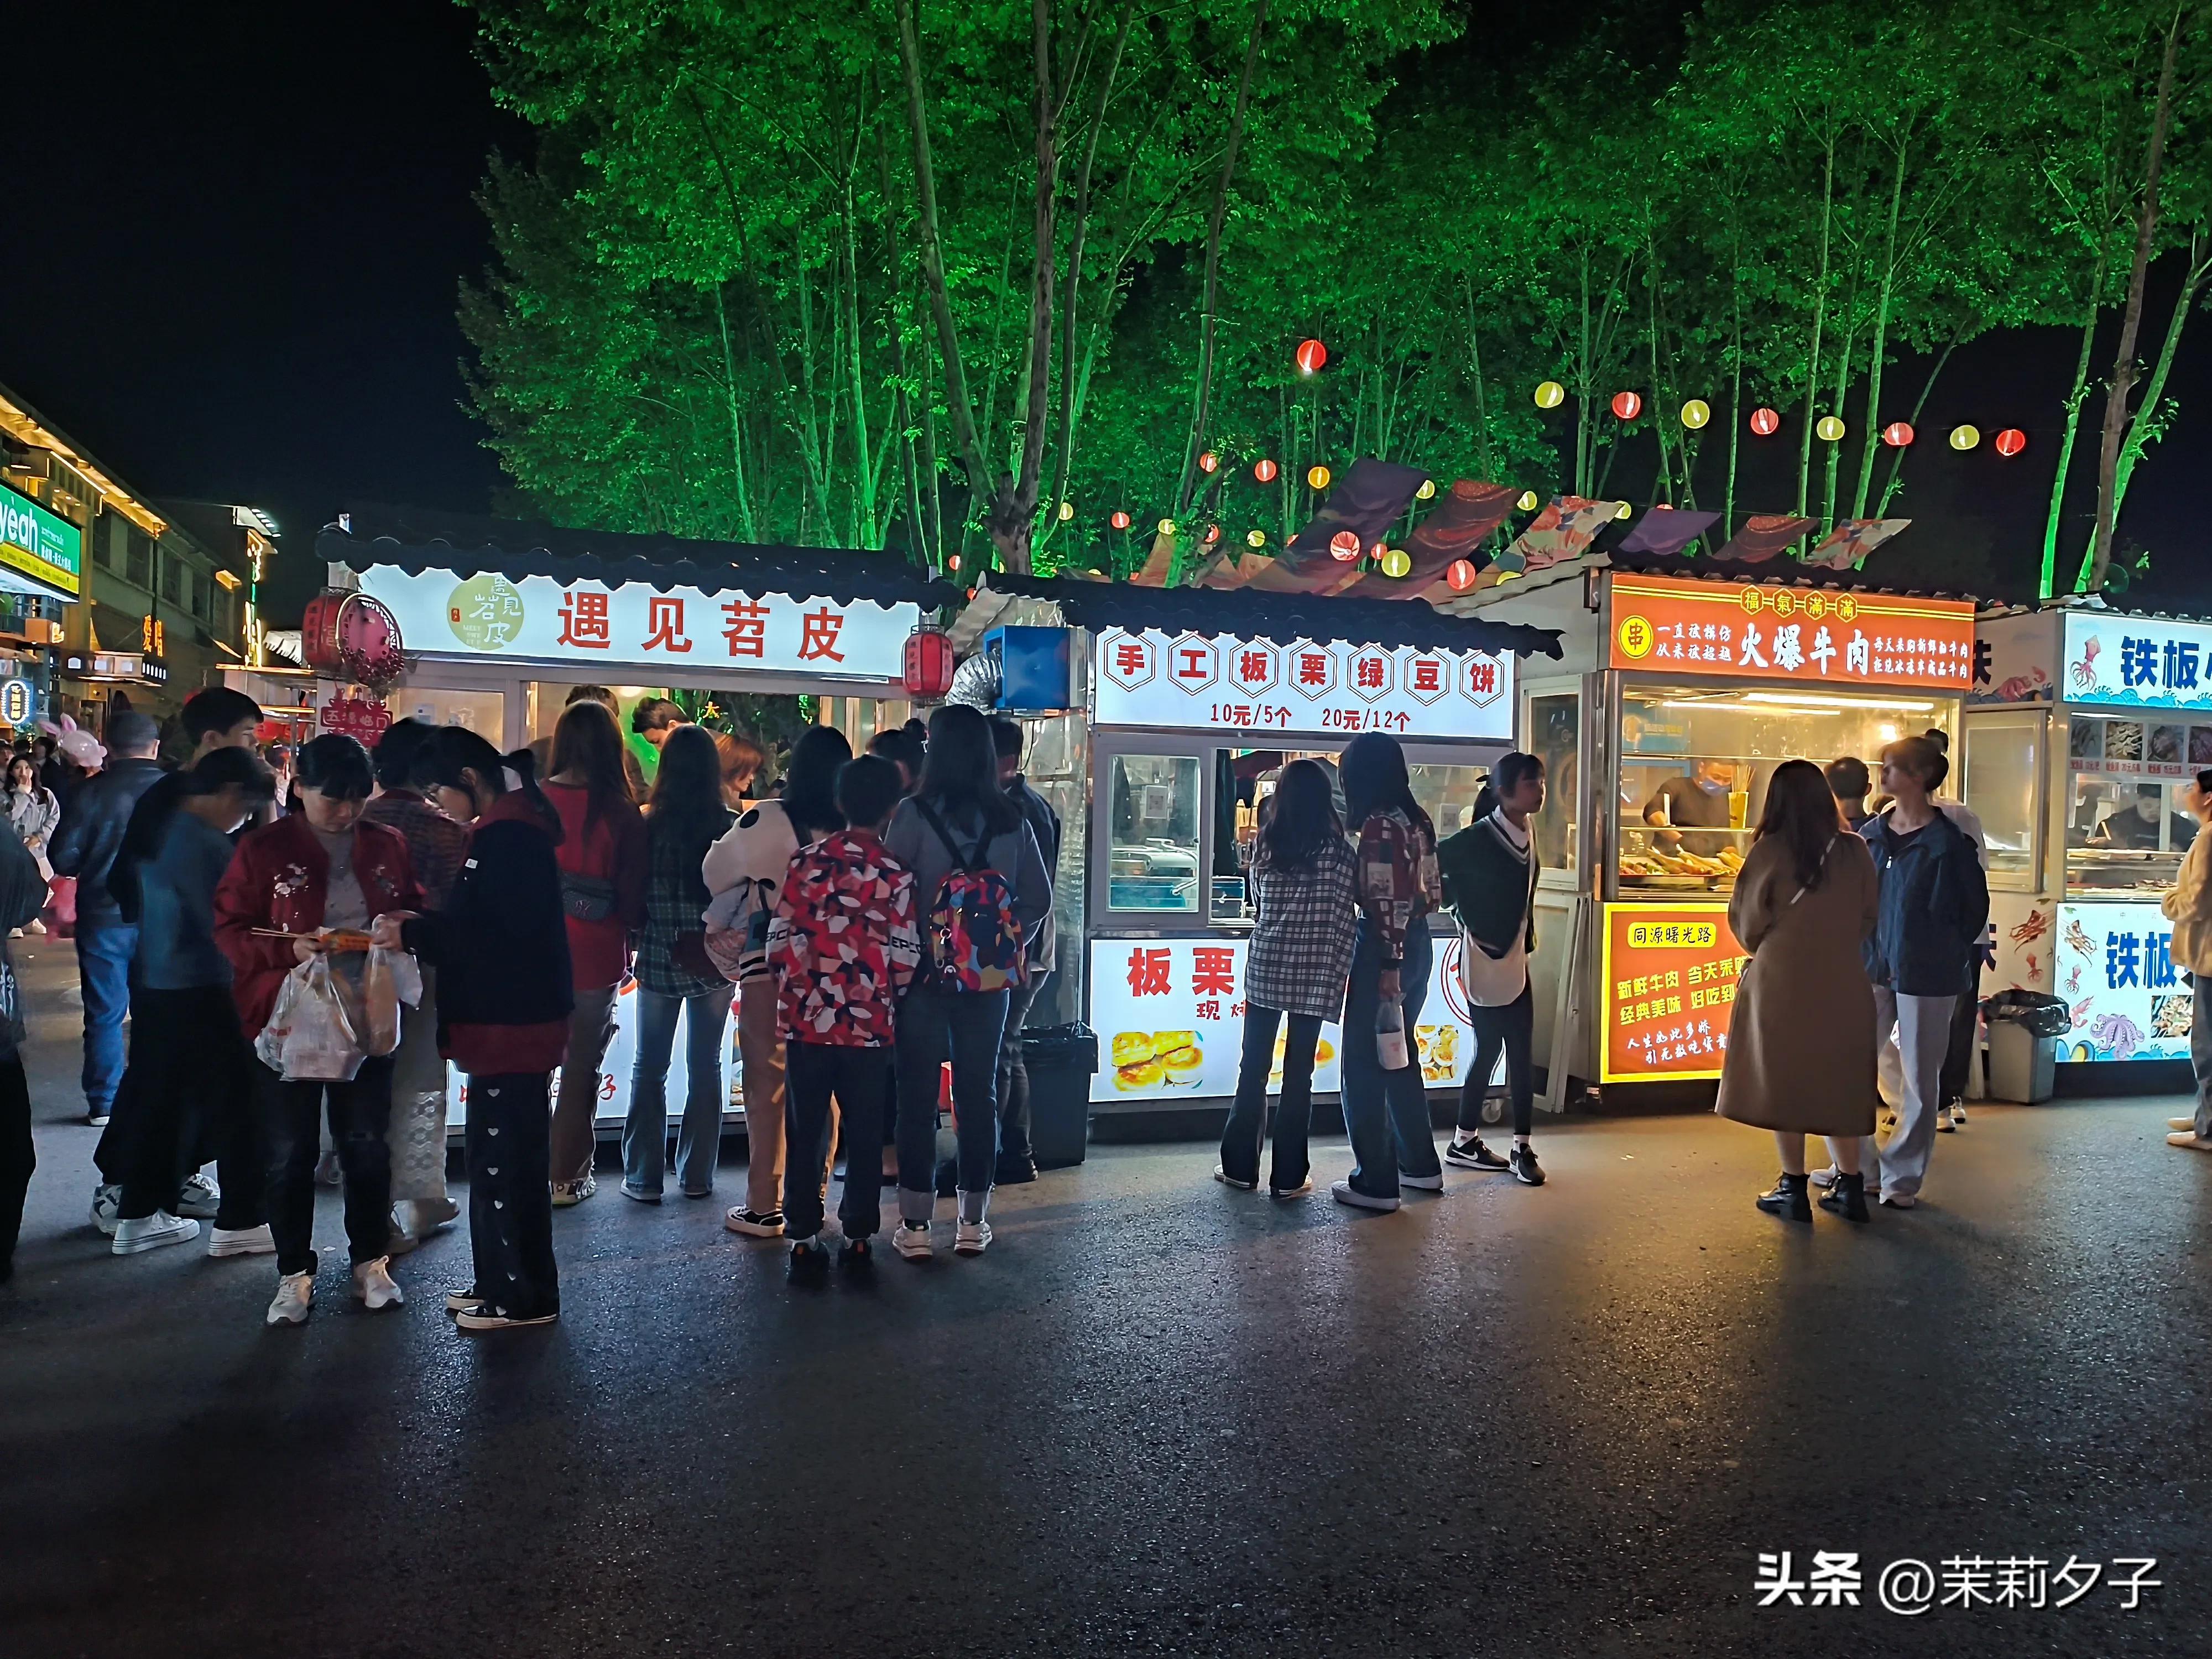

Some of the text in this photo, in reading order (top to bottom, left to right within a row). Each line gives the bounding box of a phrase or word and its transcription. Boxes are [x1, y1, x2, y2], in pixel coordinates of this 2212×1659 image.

[557, 592, 845, 663] 遇见苕皮
[1628, 622, 1644, 650] 串
[1657, 622, 1732, 642] 一直被模仿
[1738, 622, 1869, 676] 火爆牛肉
[2121, 636, 2212, 690] 铁板
[1115, 644, 1494, 694] 手工板栗绿豆饼
[1211, 704, 1411, 732] 10元/5个 20元/12个
[1634, 927, 1712, 944] 同源曙光路
[1126, 947, 1235, 997] 板栗
[1618, 971, 1679, 1000] 新鲜牛肉
[1620, 995, 1682, 1025] 经典美味
